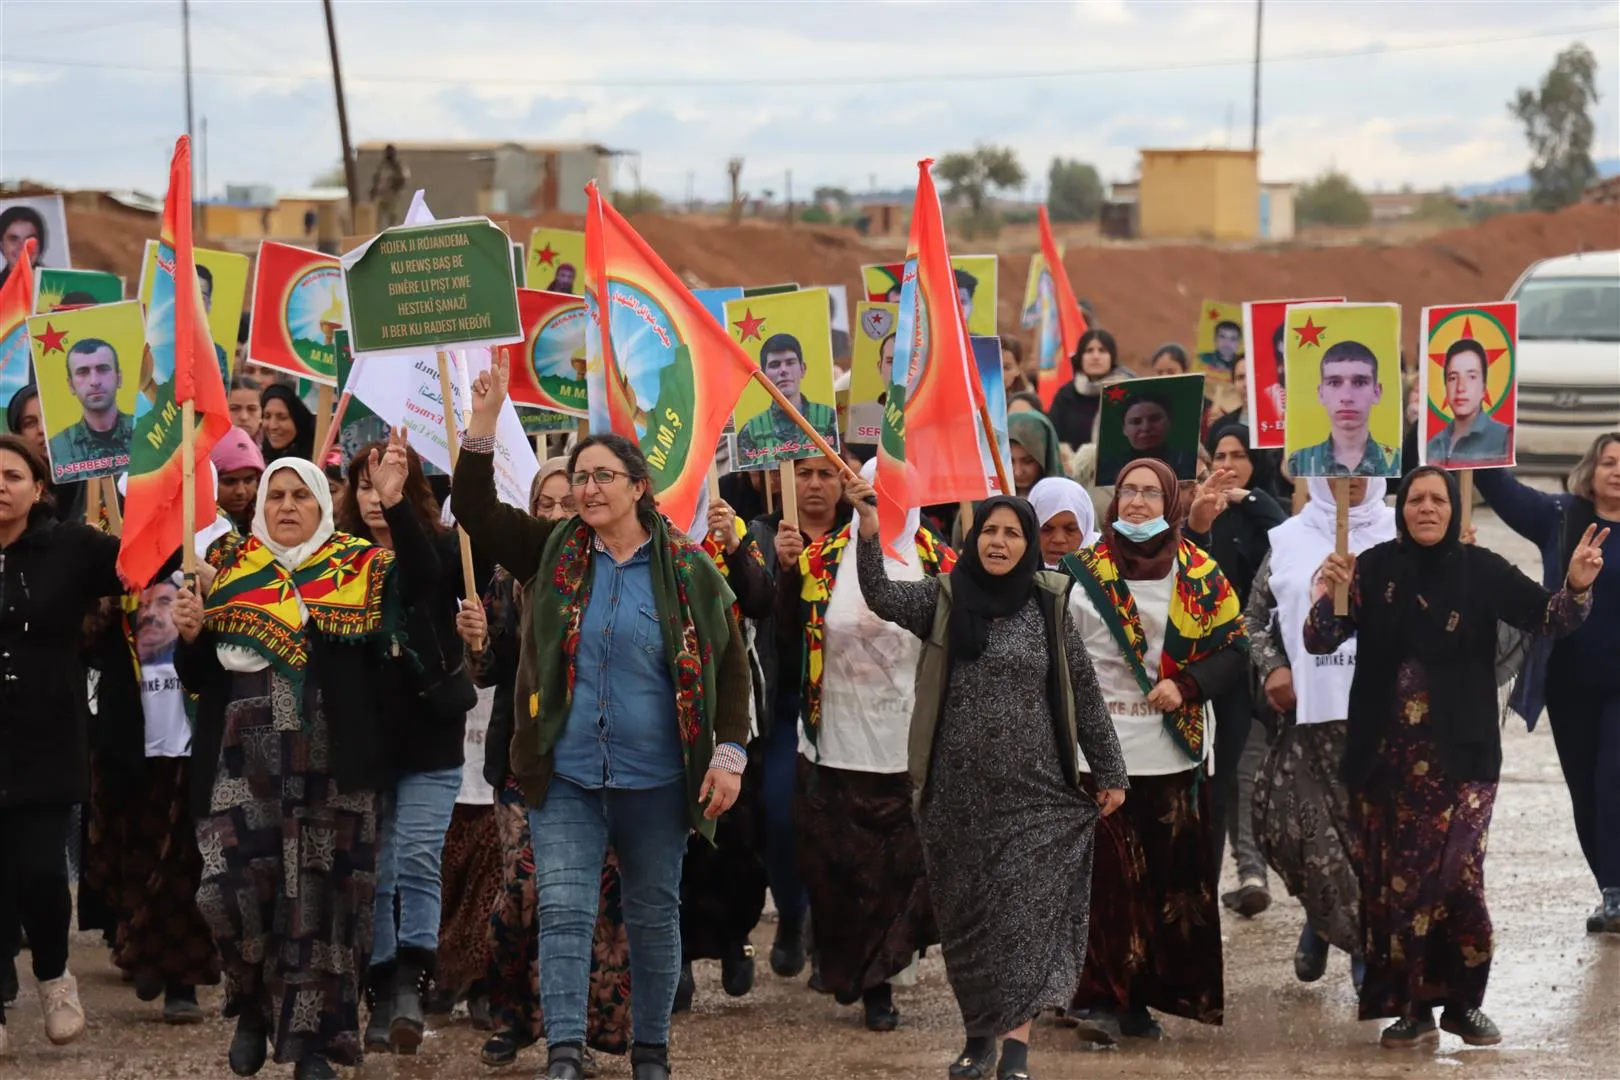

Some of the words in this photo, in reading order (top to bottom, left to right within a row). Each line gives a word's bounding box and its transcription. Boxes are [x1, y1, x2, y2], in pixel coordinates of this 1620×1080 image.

[380, 239, 407, 255] ROJEK
[409, 239, 415, 252] JI
[391, 261, 403, 274] KU
[405, 257, 431, 275] REWŞ
[432, 255, 452, 272] BAŞ
[453, 255, 464, 267] BE
[388, 279, 420, 297] BINÊRE
[421, 279, 430, 293] LI
[430, 276, 451, 294] PIŞT
[452, 275, 471, 288] XWE
[398, 297, 434, 315] HESTEKÎ
[435, 294, 466, 314] ŞANAZÎ
[381, 326, 390, 339] JI
[390, 325, 407, 337] BER
[409, 322, 423, 336] KU
[423, 319, 457, 333] RADEST
[560, 384, 587, 400] M.M.
[646, 407, 683, 472] M.M.Ş
[115, 454, 130, 466] ZA
